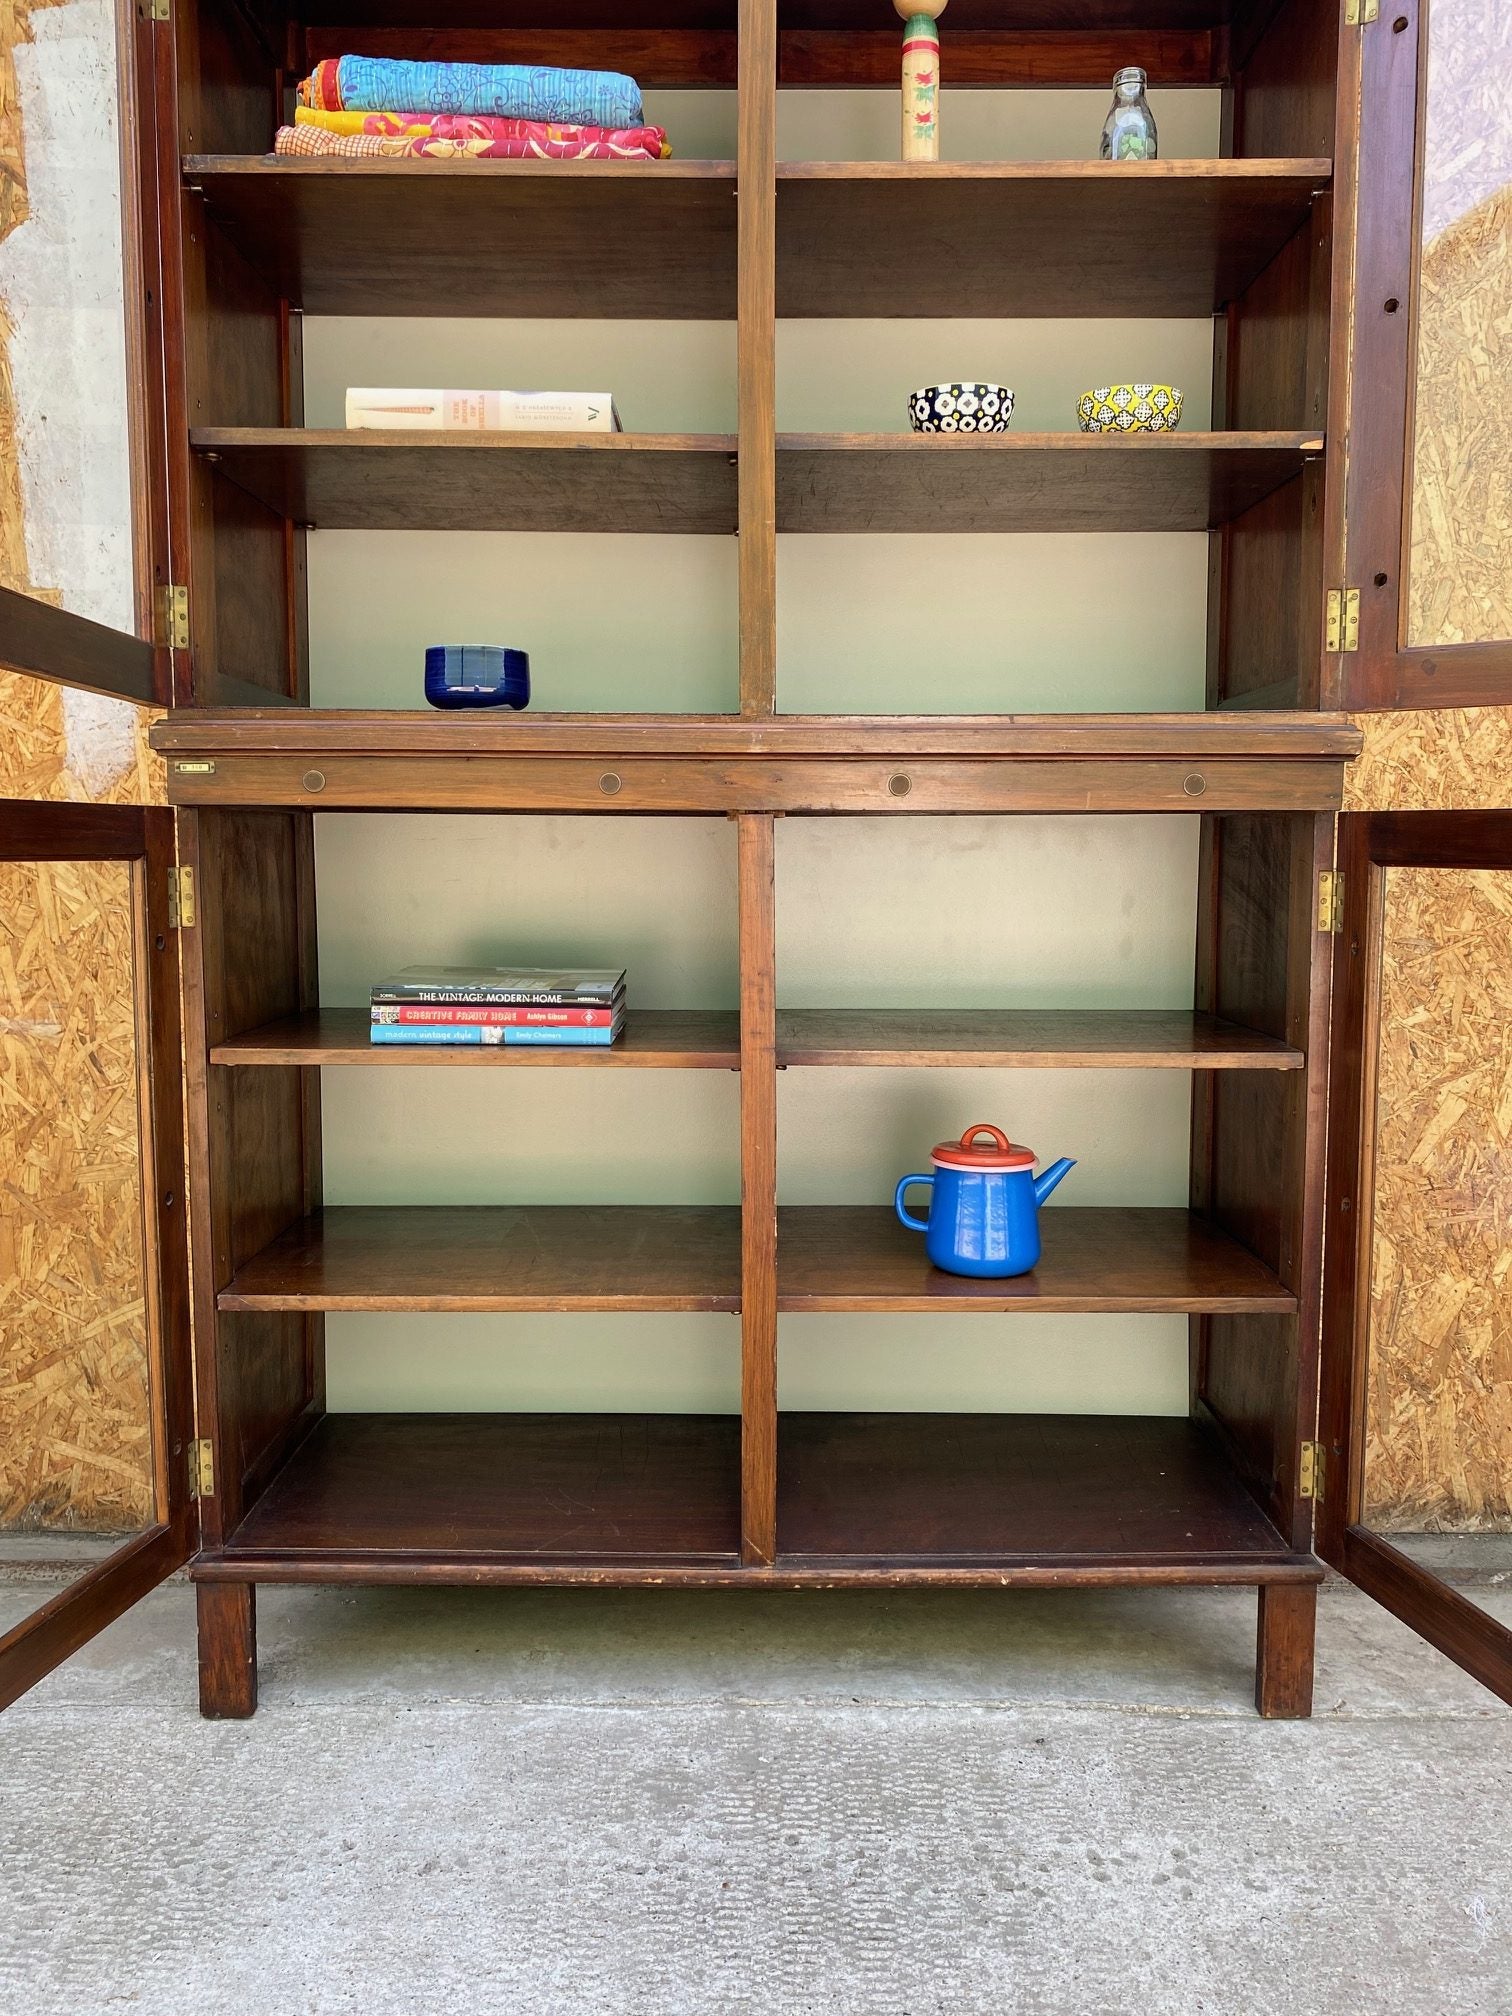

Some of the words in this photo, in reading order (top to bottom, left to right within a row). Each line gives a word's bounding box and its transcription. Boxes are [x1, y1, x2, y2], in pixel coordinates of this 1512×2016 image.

[419, 992, 436, 1001] THE
[438, 992, 483, 1002] VINTAGE
[486, 993, 530, 1003] MODERN
[532, 993, 562, 1003] HOME
[406, 1011, 453, 1020] CREATIVE
[456, 1011, 488, 1021] FAMILY
[490, 1011, 517, 1020] HOME
[527, 1012, 546, 1021] Ashlyn
[547, 1012, 567, 1020] Gibson
[385, 1030, 417, 1038] modern
[419, 1029, 451, 1040] vintage
[453, 1029, 472, 1041] style
